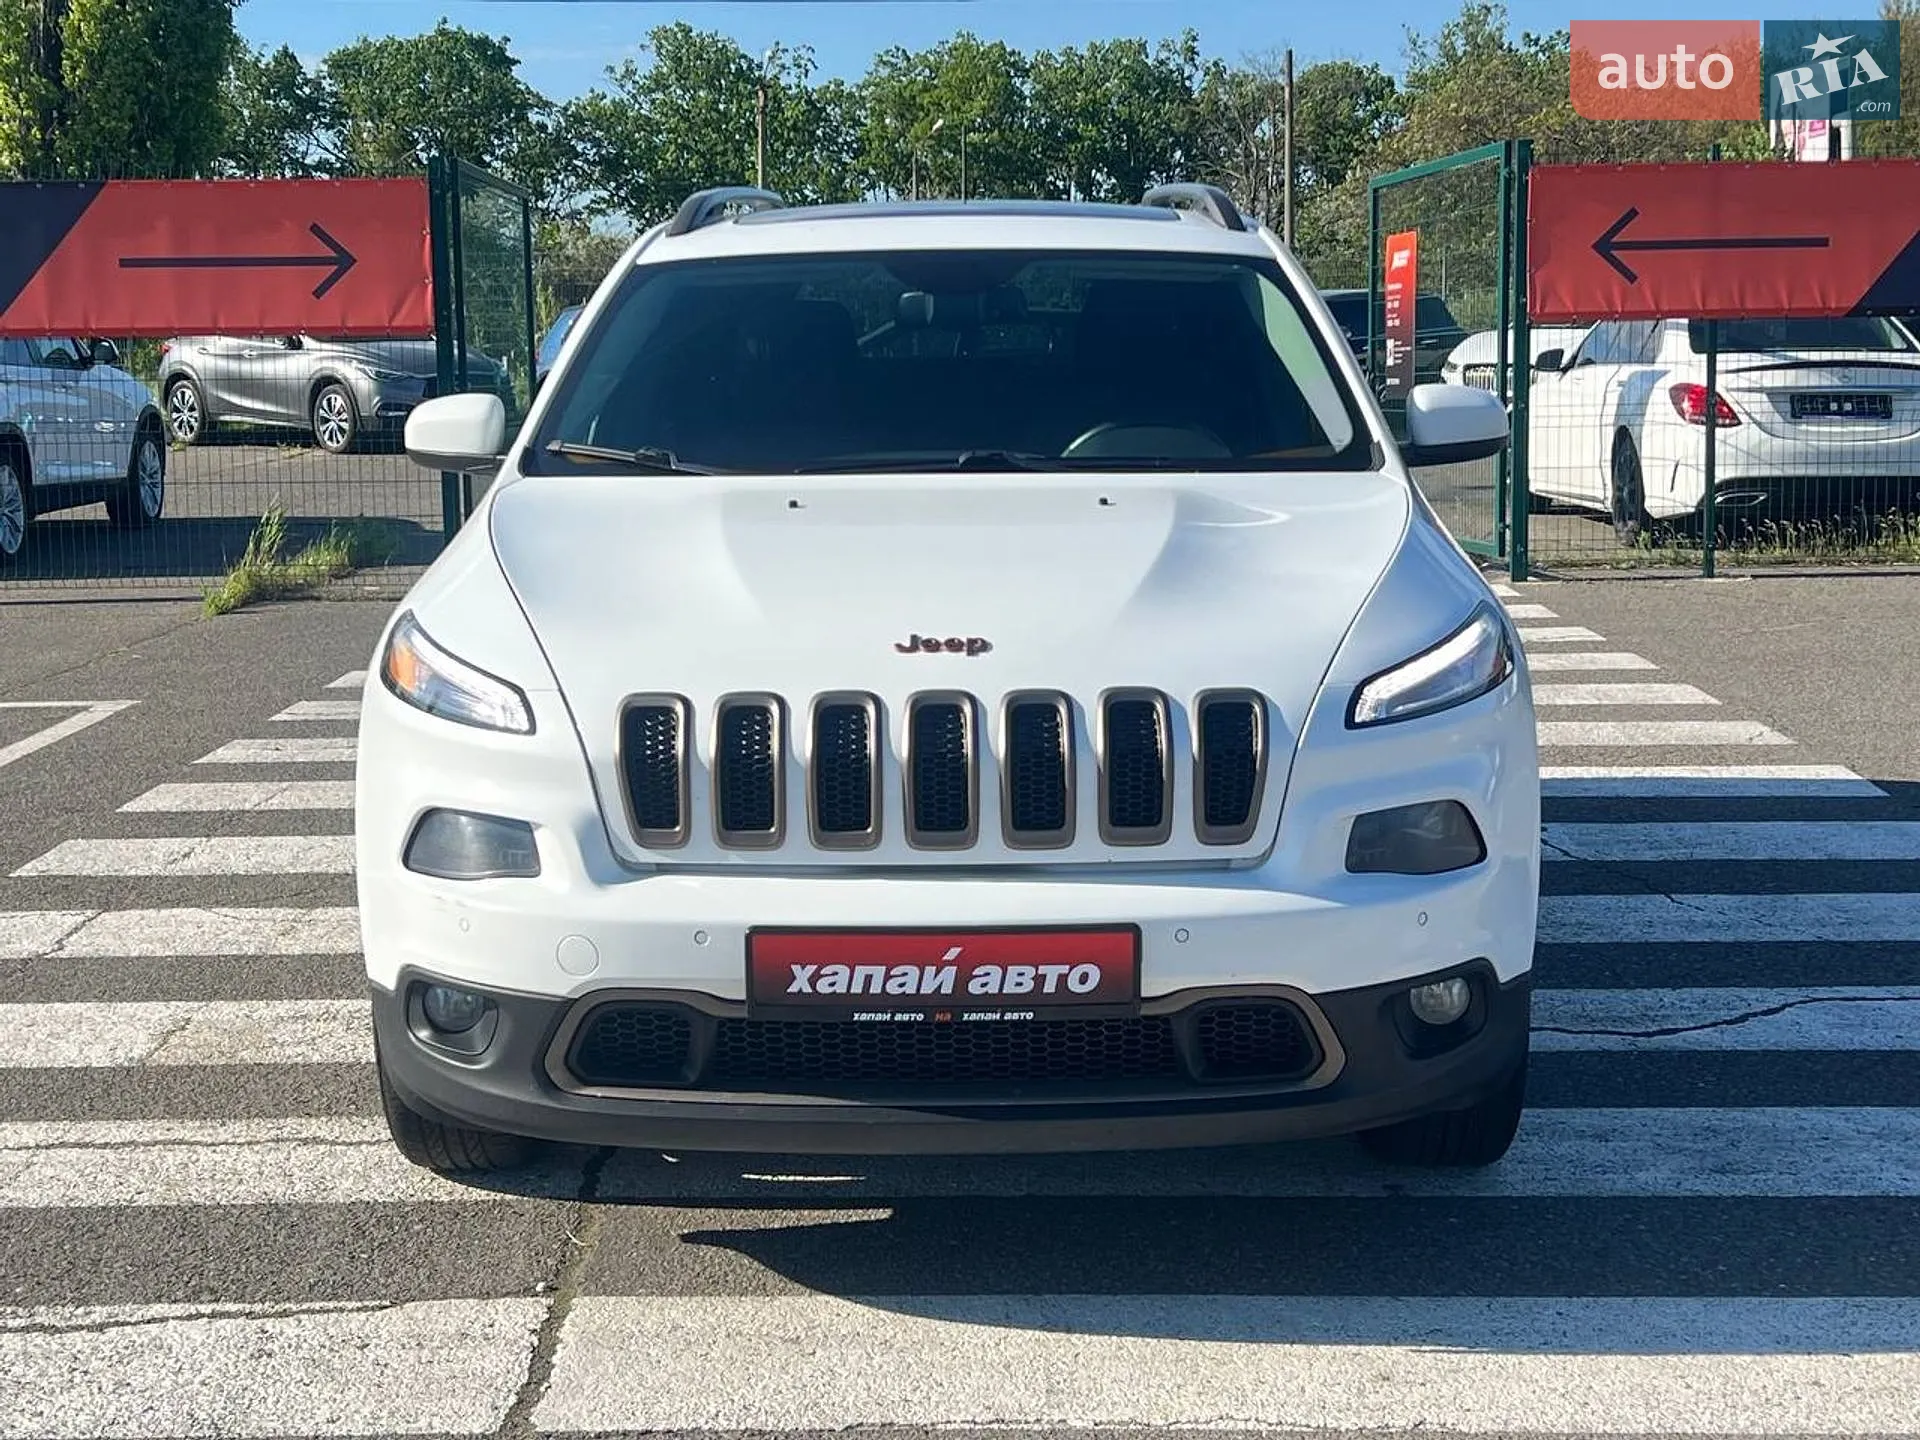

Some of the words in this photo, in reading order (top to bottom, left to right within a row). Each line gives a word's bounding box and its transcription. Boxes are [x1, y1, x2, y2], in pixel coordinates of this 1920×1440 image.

[894, 634, 993, 657] Jeep
[787, 946, 962, 994] хапай
[967, 964, 1101, 994] авто
[894, 1012, 925, 1022] авто
[1003, 1010, 1034, 1021] авто
